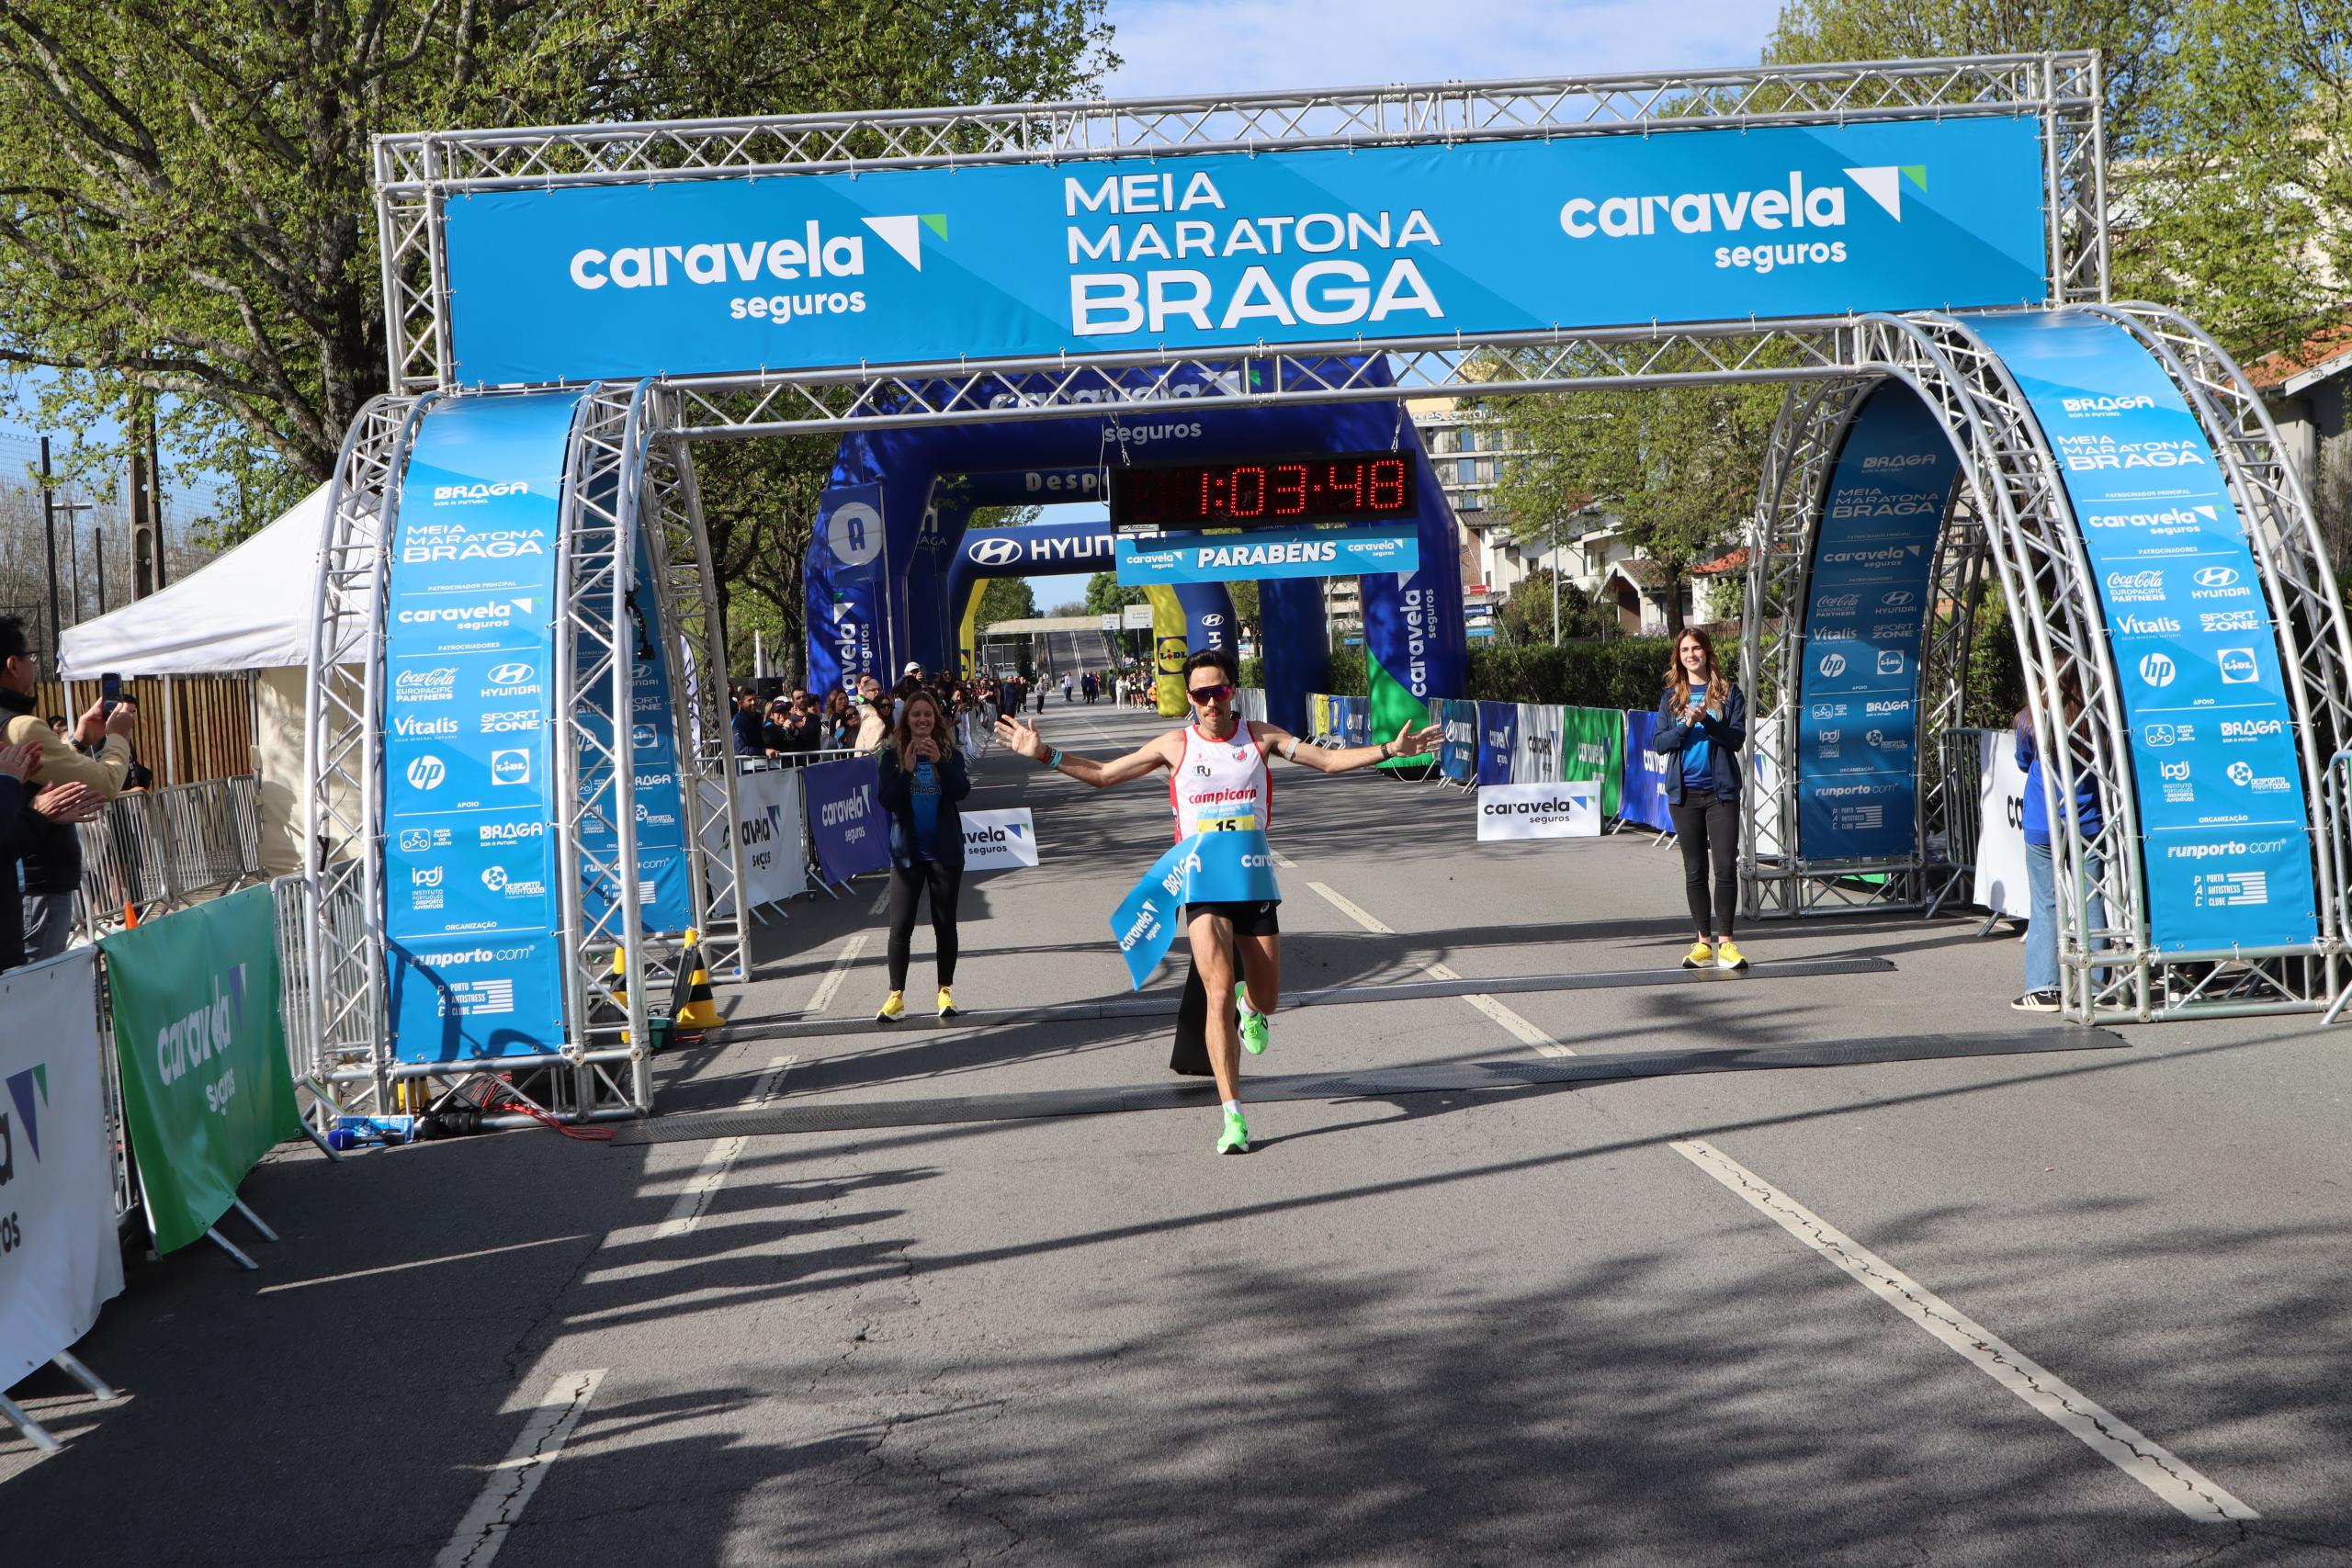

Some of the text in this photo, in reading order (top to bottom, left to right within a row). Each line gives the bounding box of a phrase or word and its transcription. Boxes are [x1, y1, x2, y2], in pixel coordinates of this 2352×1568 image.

[1064, 171, 1226, 217] MEIA
[1560, 170, 1846, 239] caravela
[1067, 209, 1442, 265] MARATONA
[569, 219, 865, 290] caravela
[1714, 241, 1847, 274] seguros
[1069, 258, 1446, 337] BRAGA
[729, 288, 866, 324] seguros
[2062, 396, 2154, 412] BRAGA
[1104, 419, 1203, 446] seguros
[2057, 434, 2116, 446] MEIA
[2062, 440, 2198, 456] MARATONA
[1863, 454, 1937, 468] BRAGA
[2066, 450, 2205, 471] BRAGA
[434, 481, 528, 500] BRAGA
[1838, 488, 1882, 497] MEIA
[1835, 493, 1939, 505] MARATONA
[1832, 502, 1935, 518] BRAGA
[2088, 507, 2197, 528] caravela
[407, 524, 466, 536] MEIA
[2150, 525, 2200, 536] seguros
[405, 528, 545, 546] MARATONA
[402, 539, 544, 564] BRAGA
[1347, 539, 1395, 552] caravela
[2139, 546, 2198, 556] PATROCINADORES
[1126, 551, 1174, 564] caravela
[1197, 537, 1338, 569] PARABÉNS
[1824, 547, 1904, 562] caravela
[1864, 560, 1902, 569] seguros
[427, 581, 516, 592] PATROCINADOR PRINCIPAL
[2191, 586, 2250, 599] HYUNDAI
[2111, 594, 2166, 603] PARTNERS
[398, 600, 511, 624] caravela
[1428, 589, 1438, 639] seguros
[1875, 606, 1917, 615] HYUNDAI
[2199, 610, 2256, 622] SPORT
[457, 619, 510, 631] seguros
[1873, 623, 1915, 632] SPORT
[2116, 614, 2181, 634] Vitalis
[2201, 620, 2260, 632] ZONE
[1813, 626, 1858, 640] Vitalis
[1872, 630, 1913, 639] ZONE
[437, 641, 500, 651] PATROCINADORES
[862, 623, 873, 674] seguros
[1400, 589, 1428, 697] caravela
[396, 686, 454, 695] EUROPACIFIC
[481, 684, 540, 698] HYUNDAI
[396, 693, 453, 702] PARTNERS
[1866, 700, 1909, 712] BRAGA
[481, 709, 541, 723] SPORT
[393, 714, 459, 736] Vitalis
[481, 719, 540, 733] ZONE
[2221, 720, 2281, 736] BRAGA
[635, 774, 672, 787] RAGA
[821, 787, 864, 827] caravela
[1484, 796, 1570, 816] caravela
[1216, 819, 1237, 831] 15
[1529, 815, 1570, 825] seguros
[2199, 814, 2248, 823] ORGANIZAÇÃO
[480, 822, 543, 840] BRAGA
[968, 845, 1008, 855] seguros
[2206, 874, 2224, 883] PORTO
[2208, 885, 2241, 895] ANTISTRESS
[2209, 897, 2225, 907] CLUBE
[445, 921, 497, 931] ORGANIZAÇÃO
[1119, 912, 1155, 952] caravela
[450, 983, 469, 992] PORTO
[451, 993, 486, 1004] ANTISTRESS
[452, 1006, 470, 1016] CLUBE
